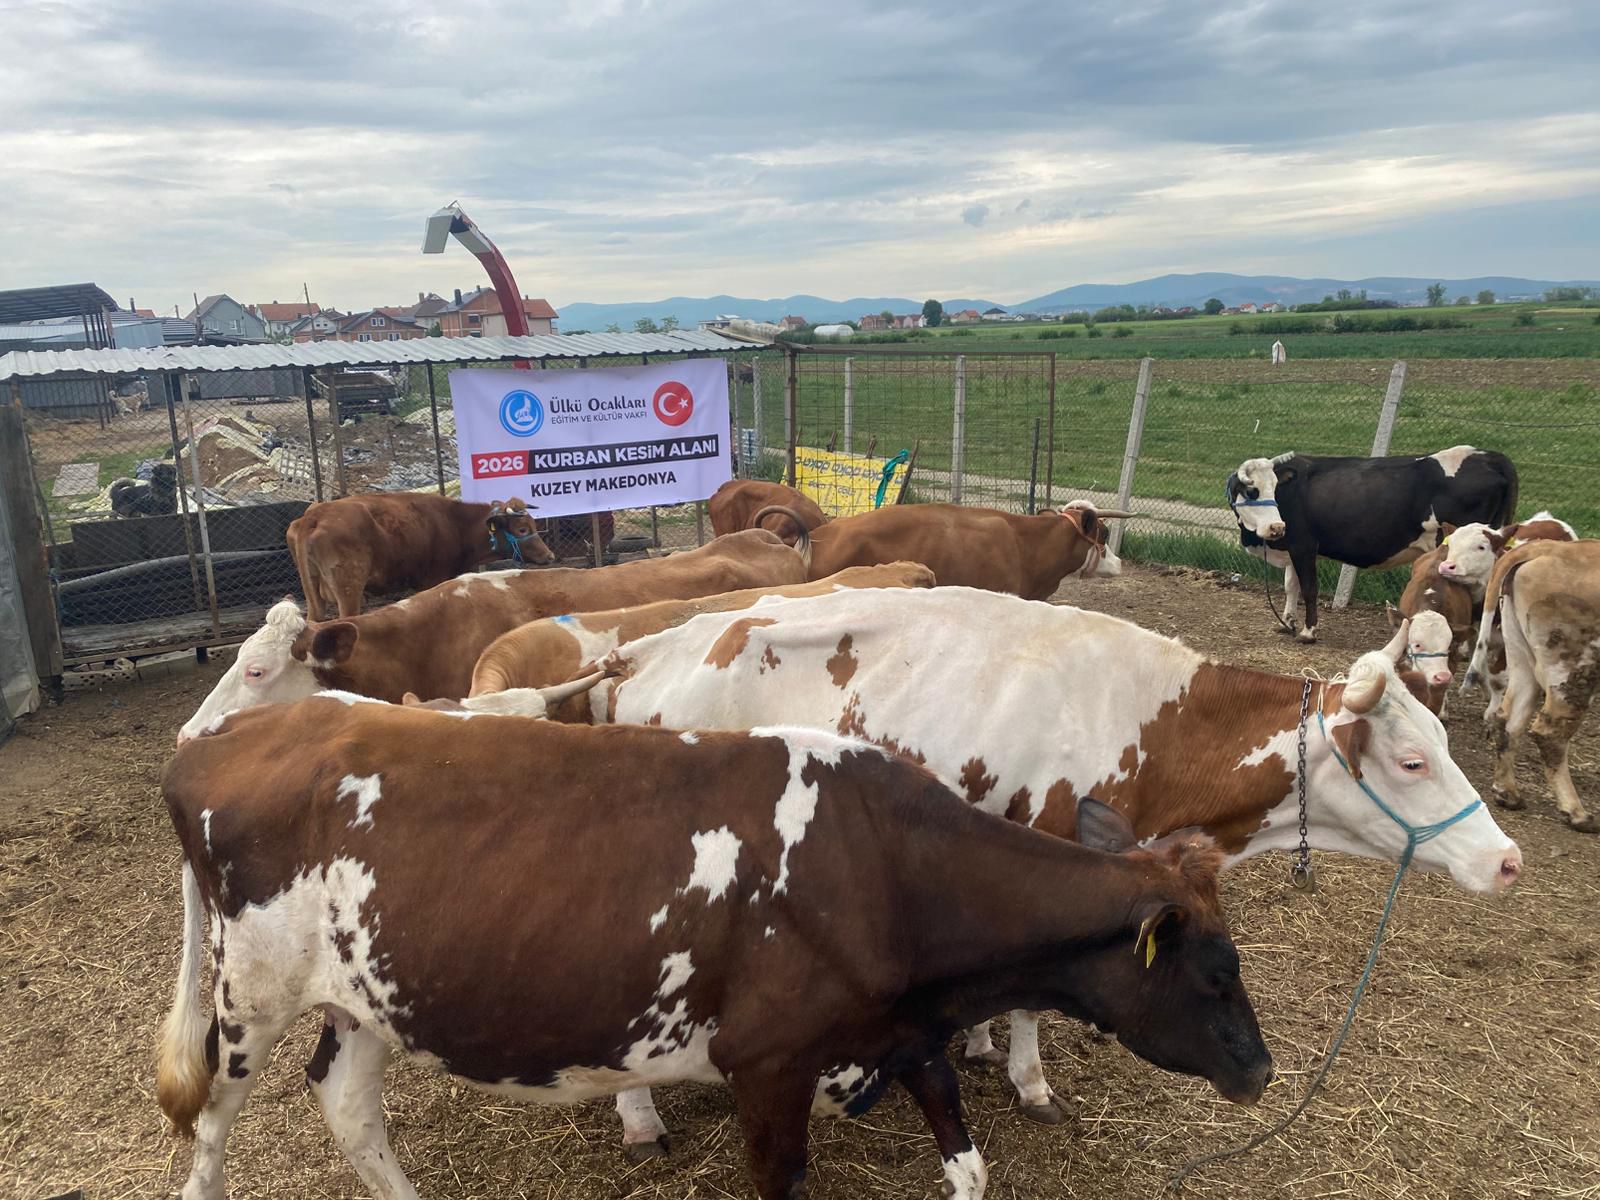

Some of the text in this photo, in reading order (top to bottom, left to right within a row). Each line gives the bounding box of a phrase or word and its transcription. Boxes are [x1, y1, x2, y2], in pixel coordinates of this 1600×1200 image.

[549, 396, 582, 414] Ülkü
[551, 410, 647, 425] EĞİTİM VE KÜLTÜR VAKFI
[477, 455, 524, 474] 2026
[534, 449, 611, 469] KURBAN
[669, 439, 716, 457] ALANI
[530, 471, 677, 497] KUZEY MAKEDONYA
